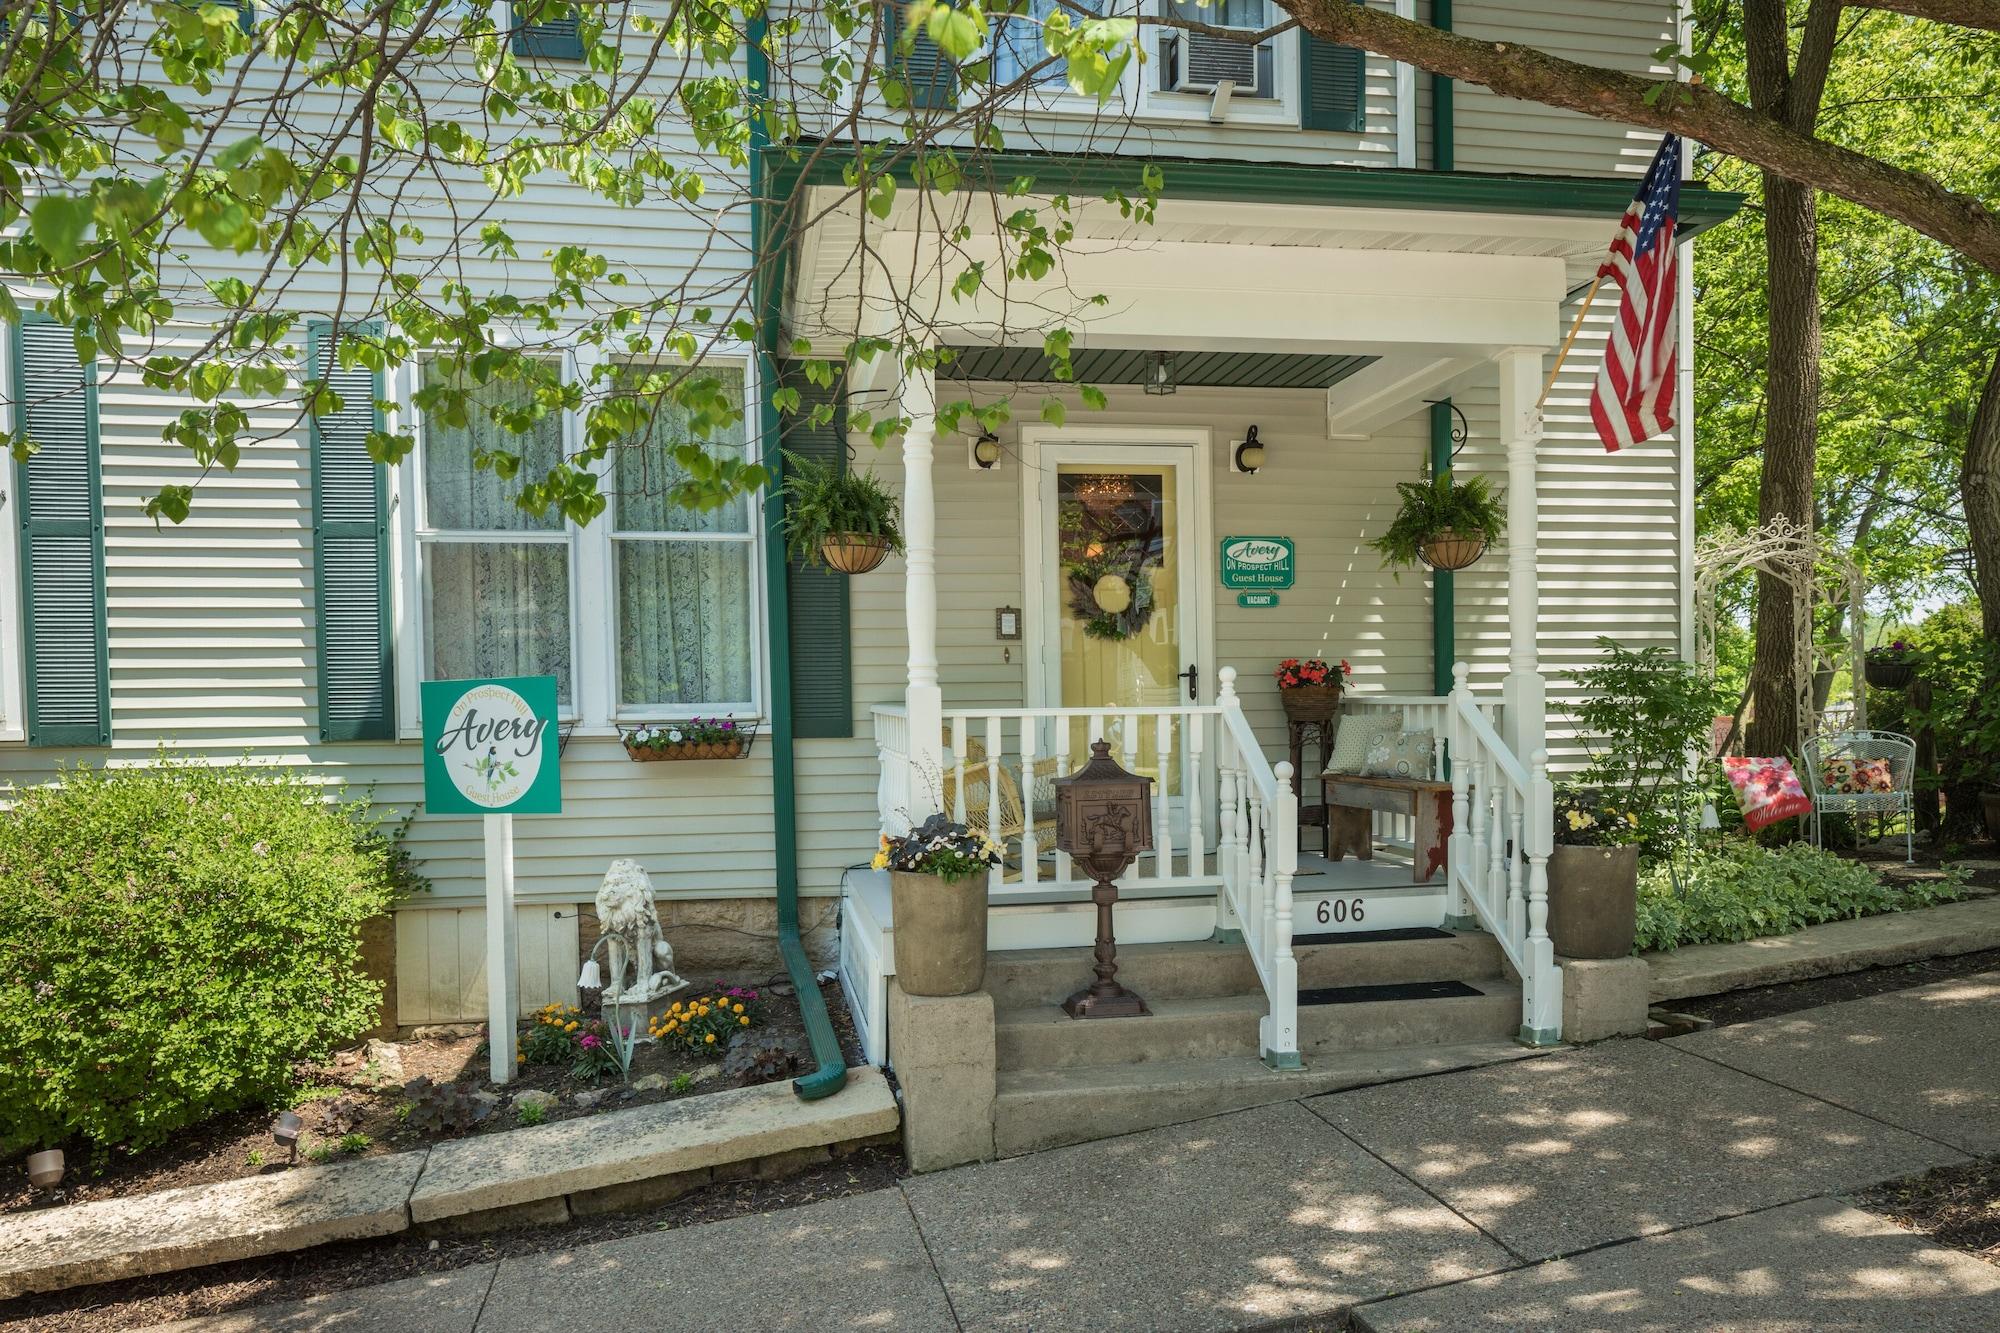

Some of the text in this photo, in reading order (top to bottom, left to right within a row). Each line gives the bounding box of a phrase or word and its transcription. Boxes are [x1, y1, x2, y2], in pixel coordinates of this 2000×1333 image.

[1233, 542, 1280, 561] Avery
[1226, 557, 1289, 571] ON PROSPECT HILL
[1232, 573, 1284, 582] Guest House
[1246, 595, 1271, 604] VACANCY
[453, 689, 529, 716] On Prospect Hill
[435, 708, 548, 757] Avery
[466, 785, 520, 802] Guest House
[1752, 803, 1800, 822] Welcome
[1317, 898, 1365, 924] 606
